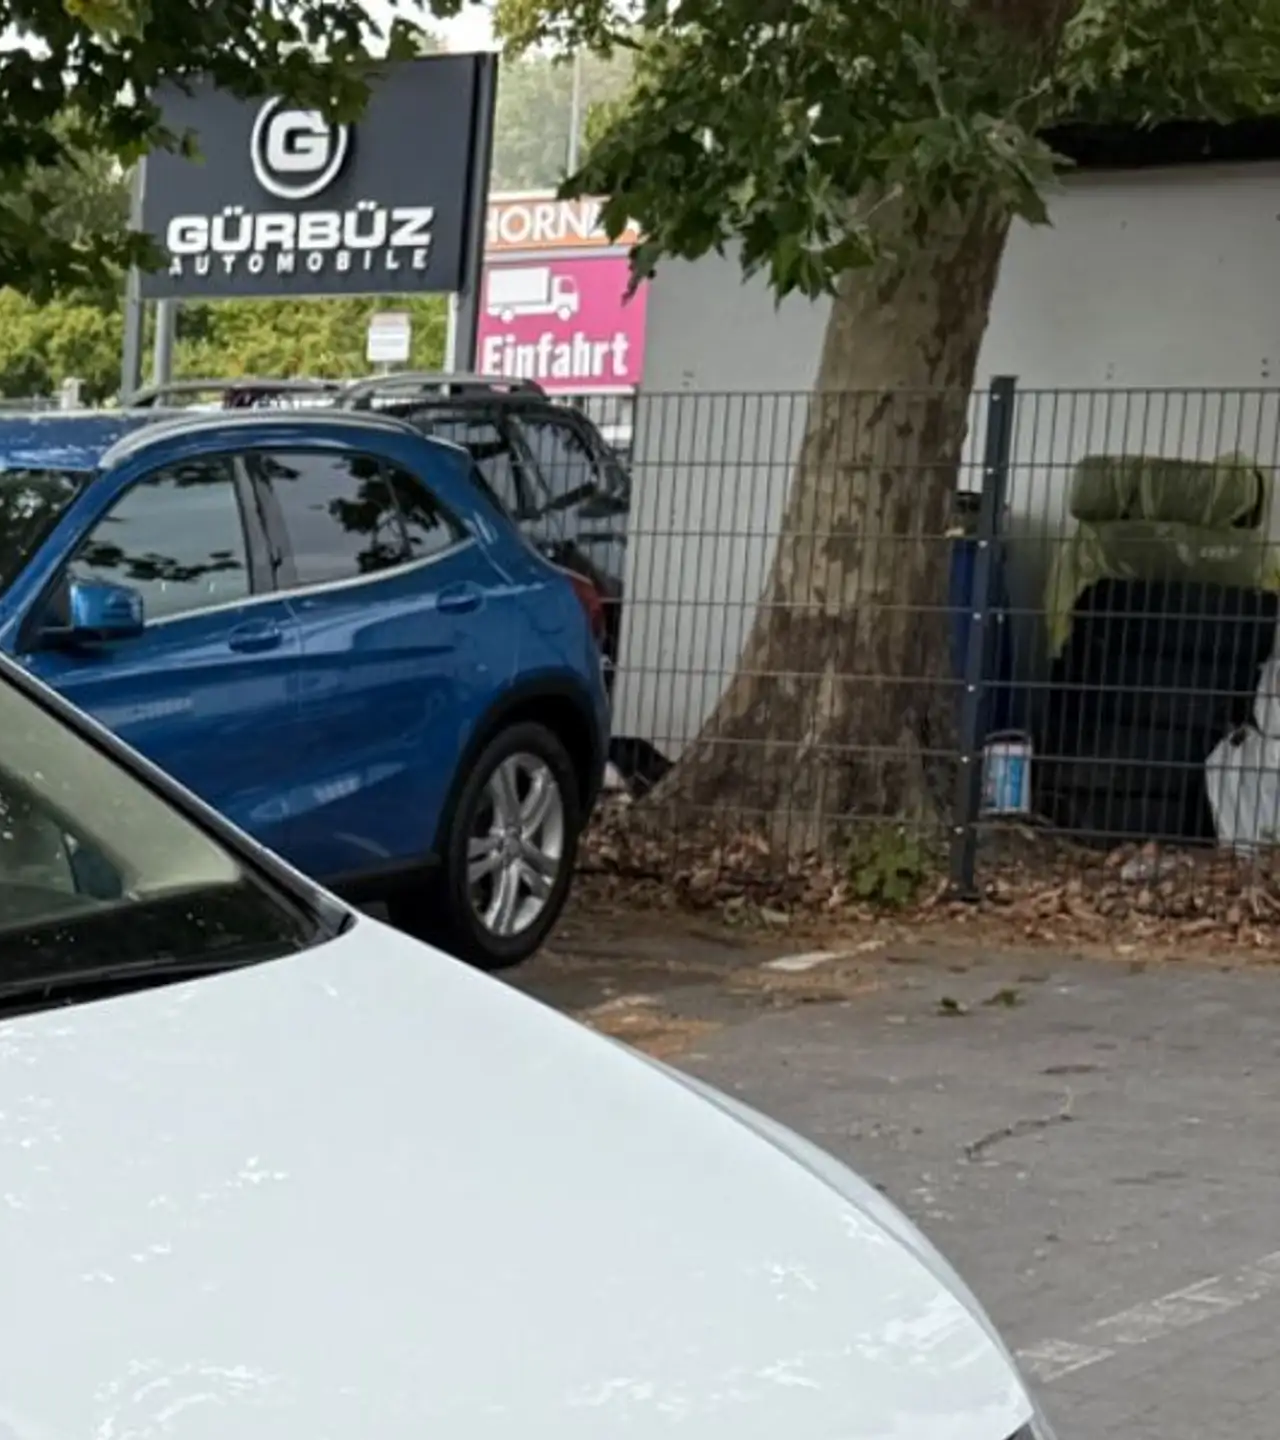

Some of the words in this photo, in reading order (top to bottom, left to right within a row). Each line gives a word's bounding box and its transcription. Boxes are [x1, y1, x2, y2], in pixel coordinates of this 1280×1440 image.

[267, 110, 329, 171] G
[167, 200, 434, 253] GÜRBÜZ
[168, 249, 429, 275] AUTOMOBILE
[481, 331, 628, 379] Einfahrt
